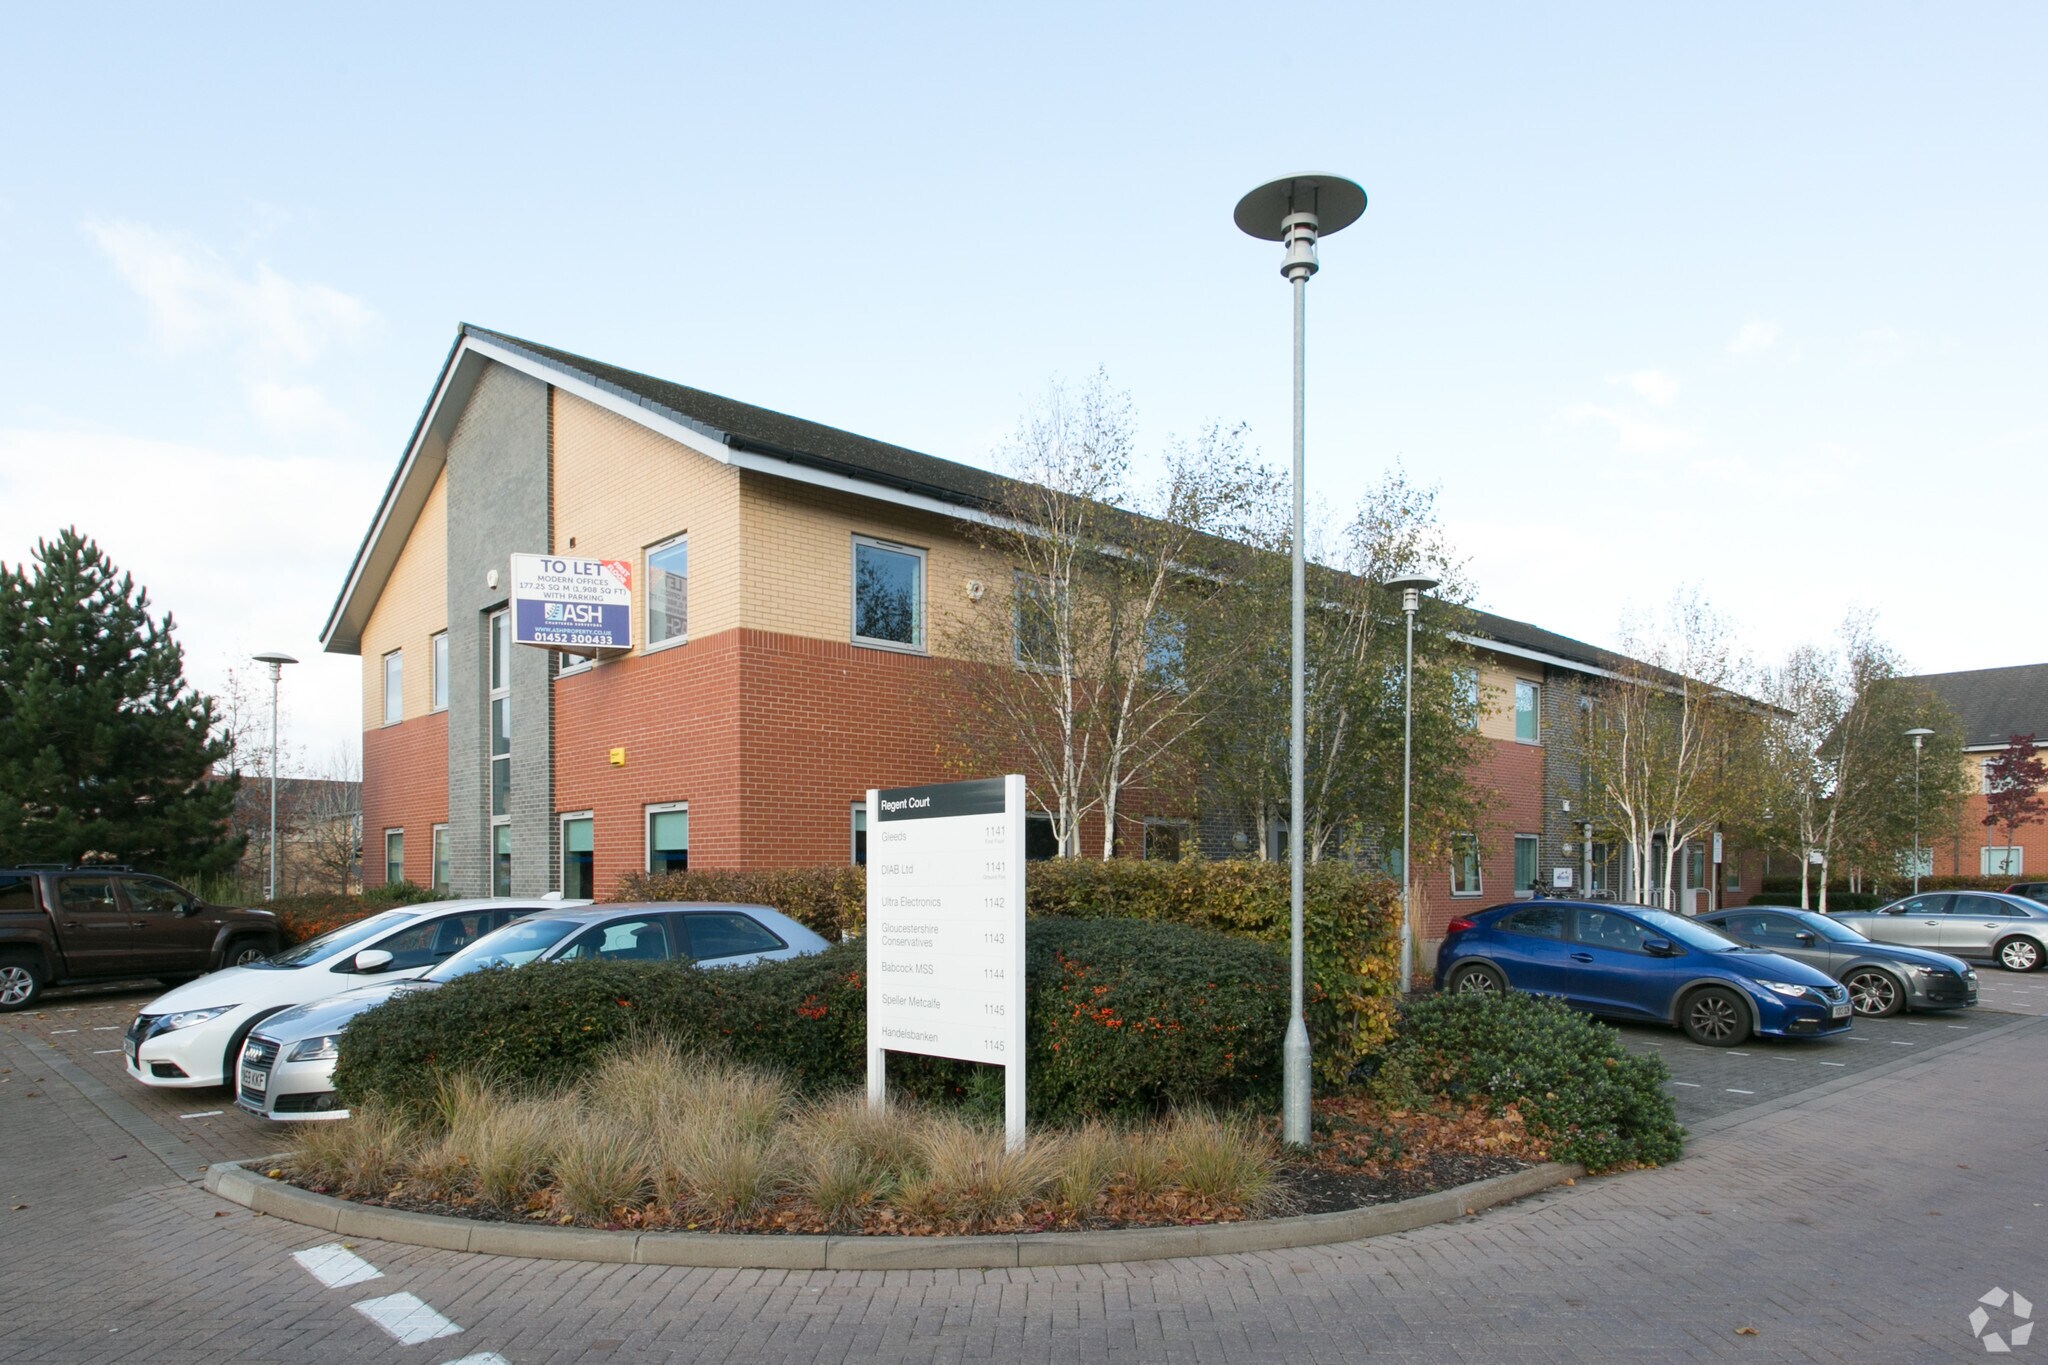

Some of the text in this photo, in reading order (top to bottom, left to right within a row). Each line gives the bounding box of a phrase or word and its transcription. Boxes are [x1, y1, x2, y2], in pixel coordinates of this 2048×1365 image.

[541, 559, 604, 576] TO LET
[607, 564, 627, 583] FLOOR
[613, 561, 630, 577] FIRST
[538, 576, 608, 586] MODERN OFFICES
[544, 592, 604, 602] WITH PARKING
[562, 604, 602, 623] ASH
[534, 626, 612, 635] WWW.ASHPROPERTY.CO.UK
[534, 632, 613, 645] 01452 300433
[881, 796, 930, 812] Regent Court
[882, 831, 907, 842] Gleeds
[986, 826, 1005, 837] 1141
[881, 864, 914, 875] DIAB Ltd
[986, 862, 1005, 872] 1141
[882, 897, 941, 907] Ultra Electronics
[985, 897, 1005, 908] 1142
[882, 923, 939, 935] Gloucestershire
[882, 936, 933, 948] Conservatives
[985, 933, 1005, 944] 1143
[882, 962, 934, 975] Babcock MSS
[985, 968, 1004, 980] 1144
[882, 994, 941, 1009] Speller Metcalfe
[985, 1004, 1005, 1016] 1145
[882, 1027, 939, 1042] Handelsbanken
[985, 1040, 1005, 1051] 1145
